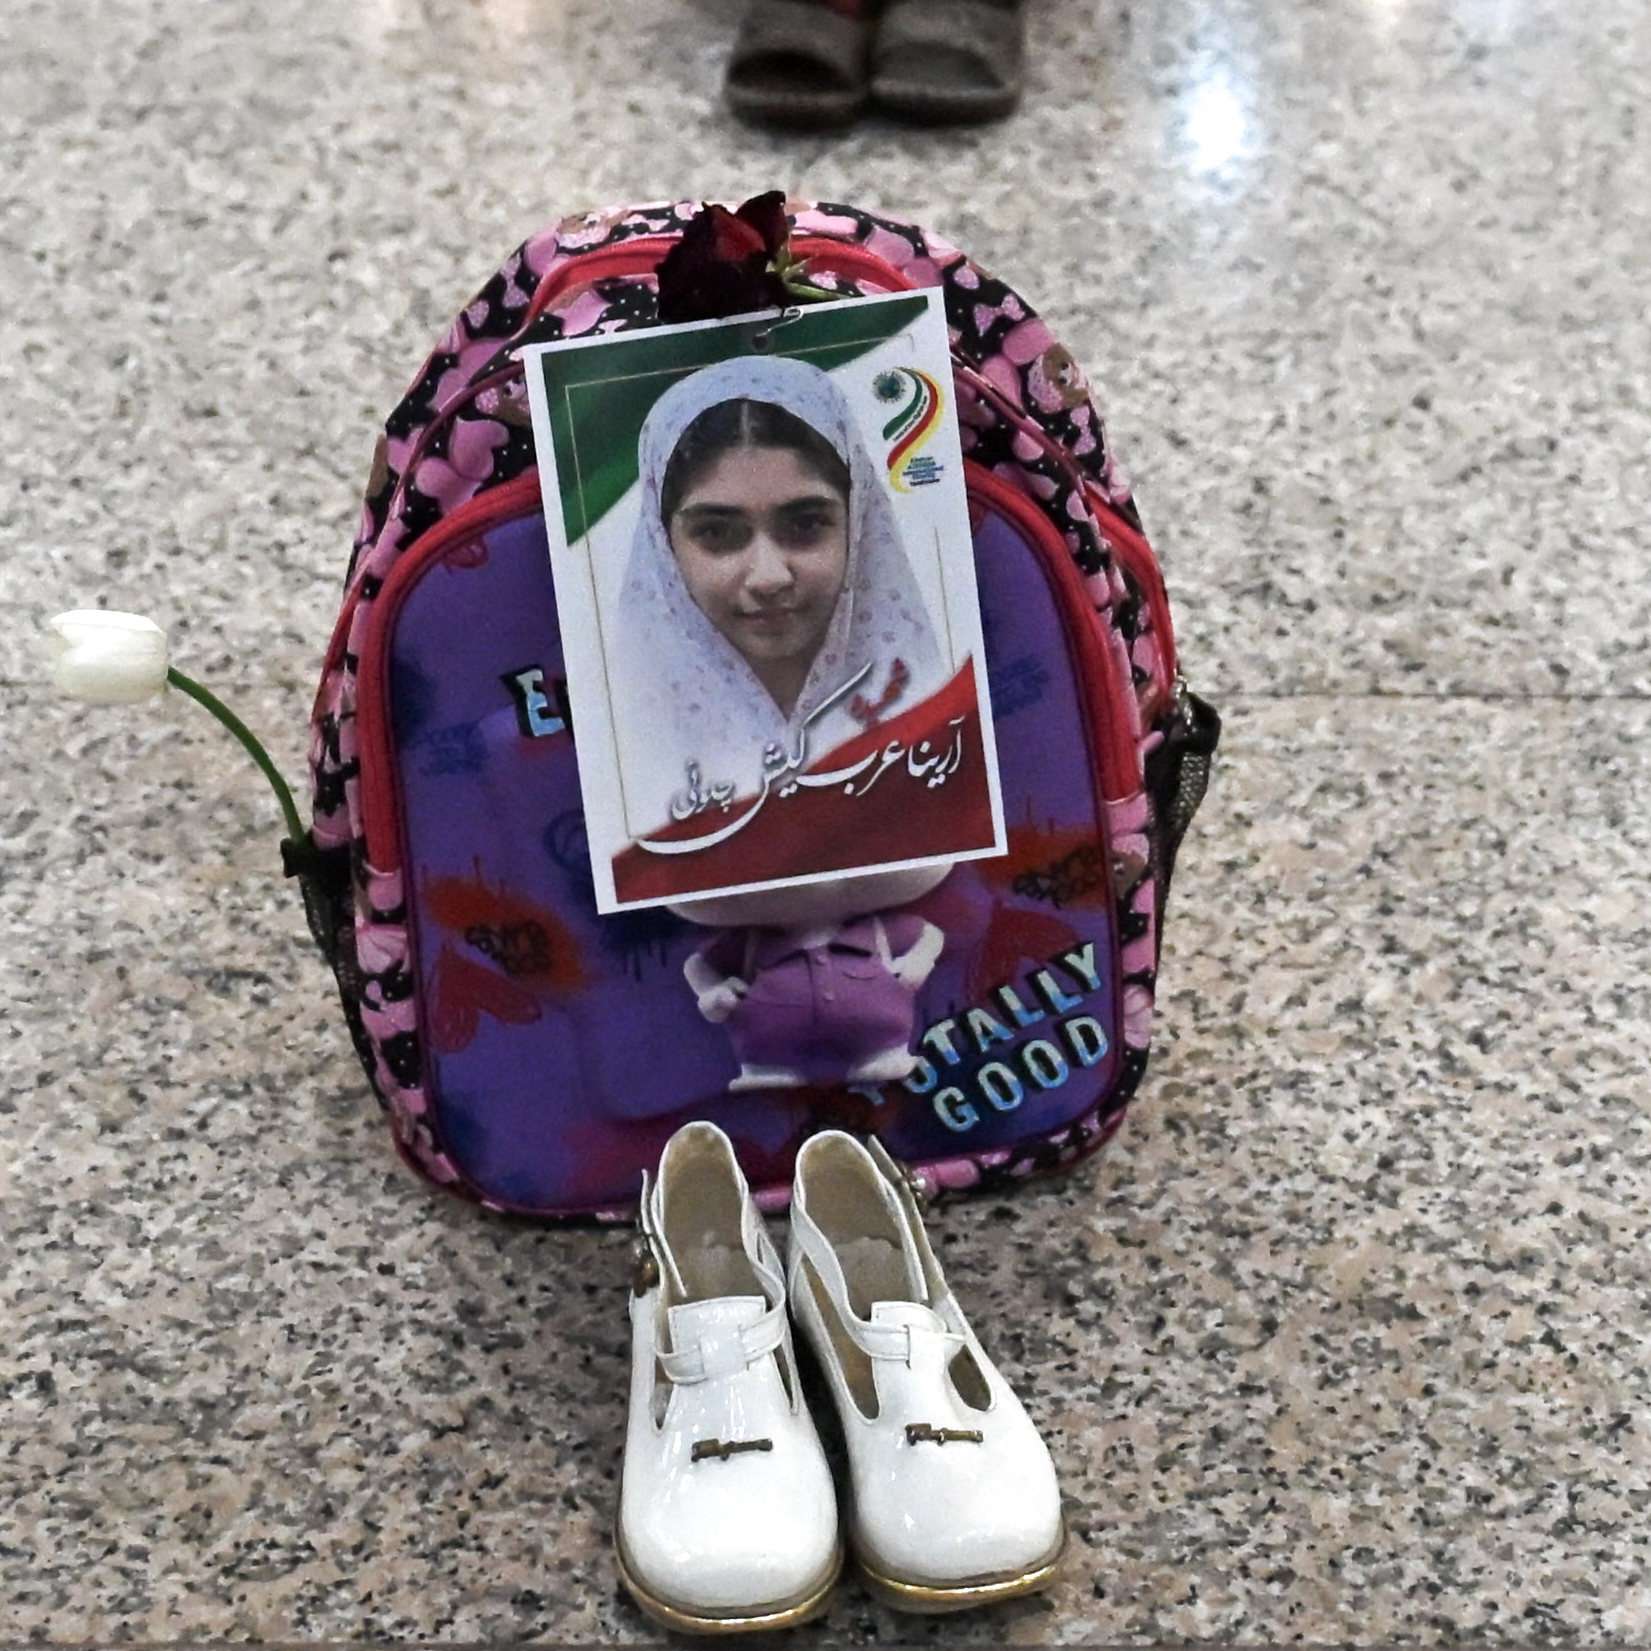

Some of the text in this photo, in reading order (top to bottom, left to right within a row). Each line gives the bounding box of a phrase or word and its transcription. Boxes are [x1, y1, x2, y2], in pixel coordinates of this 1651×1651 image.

[796, 740, 905, 796] عرب
[907, 716, 966, 788] آرینا
[932, 1015, 1109, 1133] GOOD
